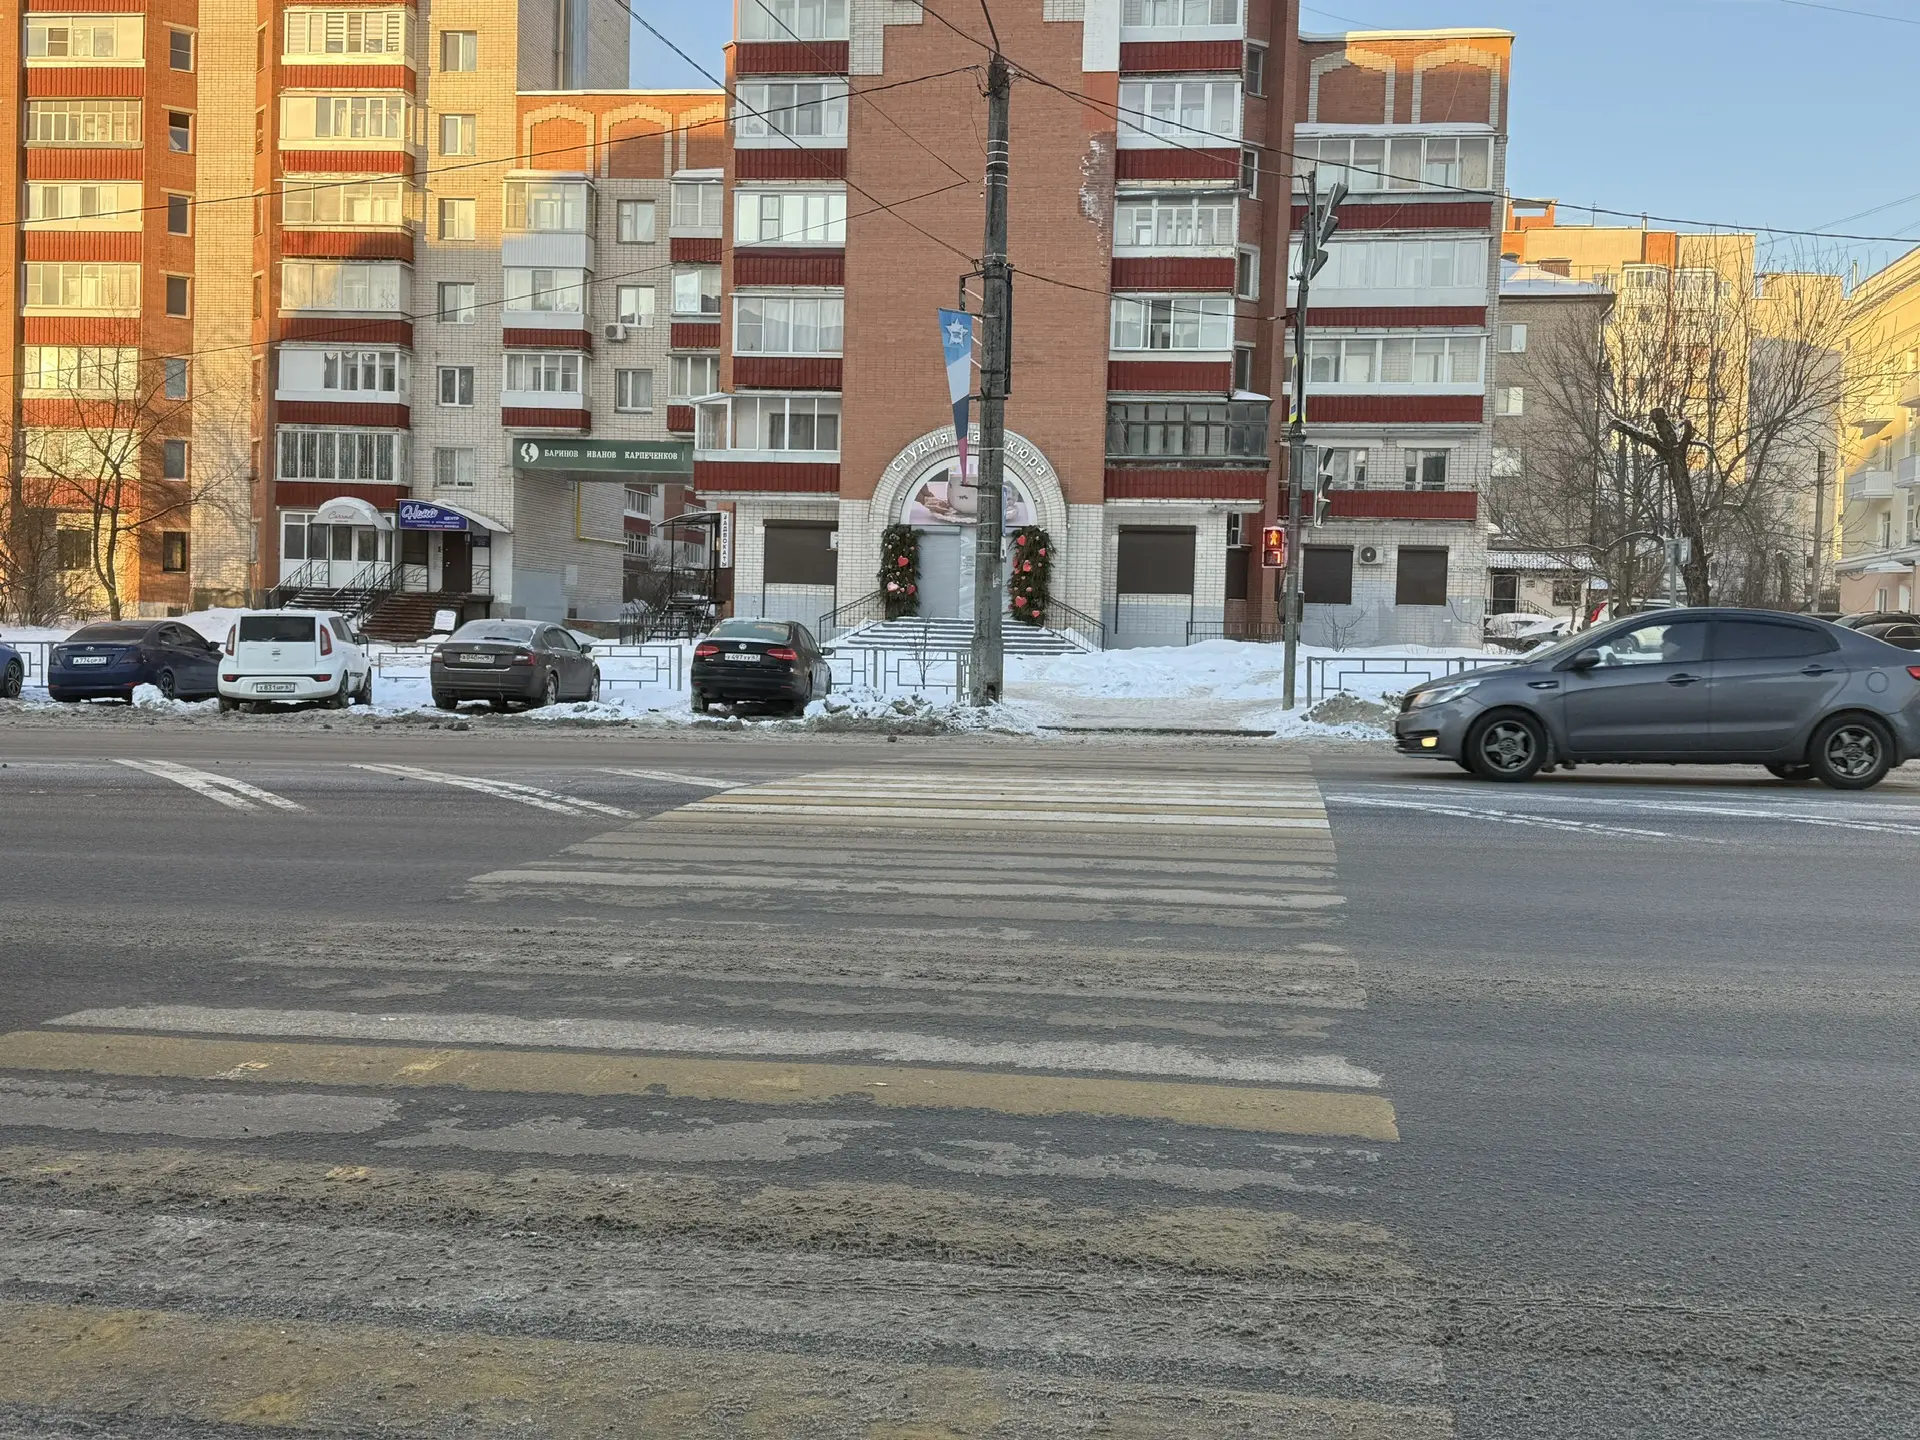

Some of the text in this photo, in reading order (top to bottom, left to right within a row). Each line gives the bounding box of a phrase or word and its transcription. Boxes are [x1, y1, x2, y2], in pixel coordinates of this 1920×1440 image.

[544, 449, 678, 460] БАРИНОВ ИВАНОВ КАРПЕЧЕНКОВ
[891, 433, 949, 472] студия
